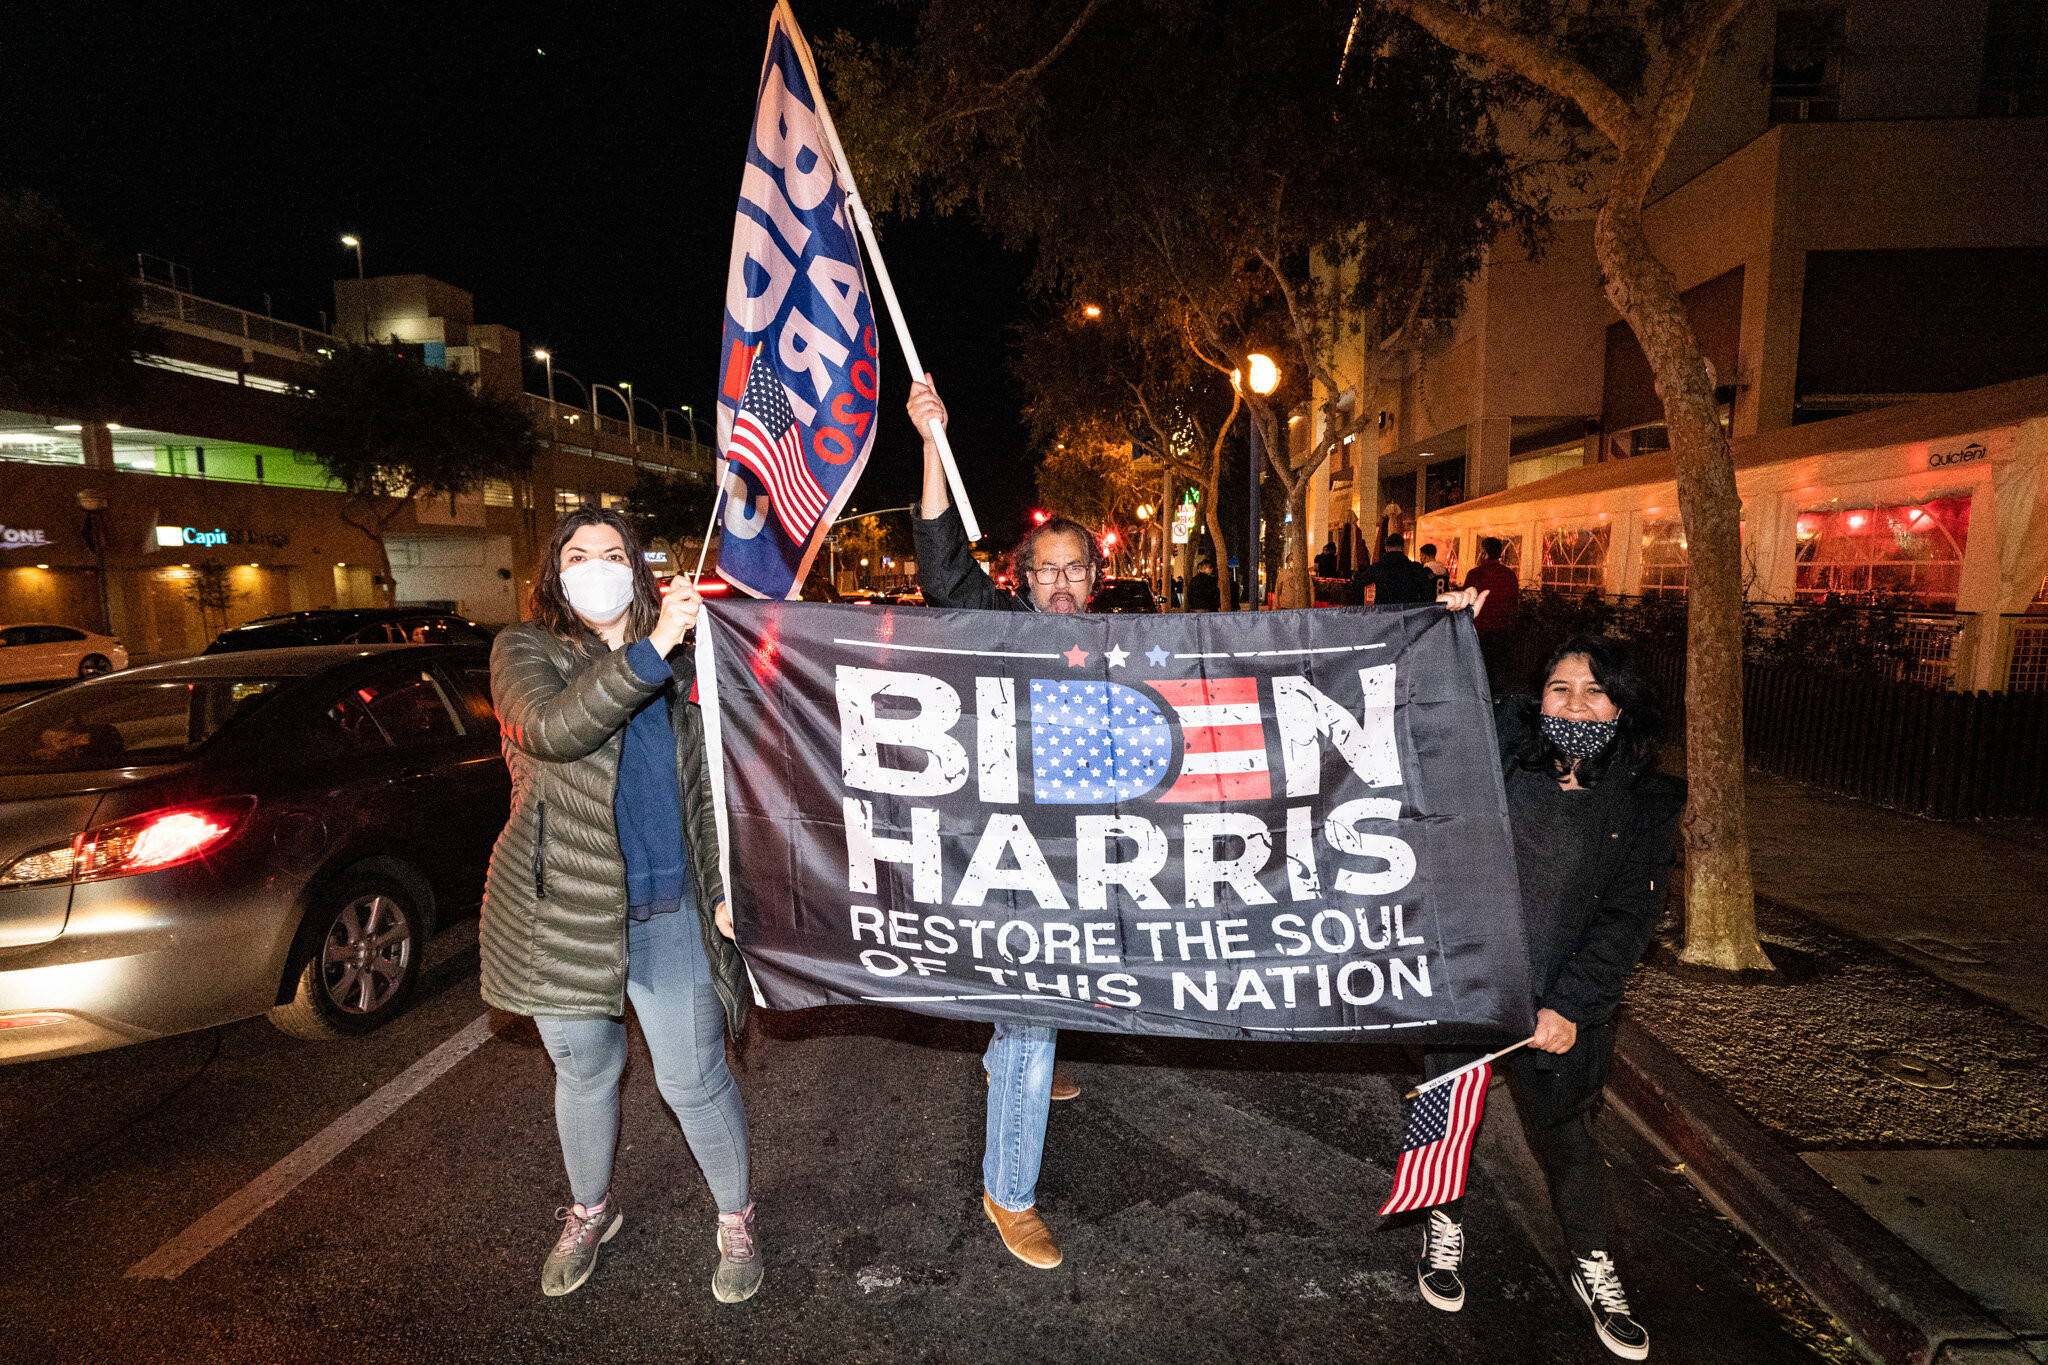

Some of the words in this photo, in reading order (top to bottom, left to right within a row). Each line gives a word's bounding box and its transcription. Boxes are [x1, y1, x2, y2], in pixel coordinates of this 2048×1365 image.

[1929, 446, 1987, 467] Quictent
[0, 525, 46, 543] ONE
[834, 663, 1404, 804] BIDEN
[842, 797, 1417, 909] HARRIS
[850, 905, 1120, 964] RESTORE
[1136, 917, 1254, 962] THE
[1270, 904, 1425, 956] SOUL
[859, 948, 947, 977] OF
[975, 965, 1142, 1008] THIS
[1172, 955, 1434, 1012] NATION
